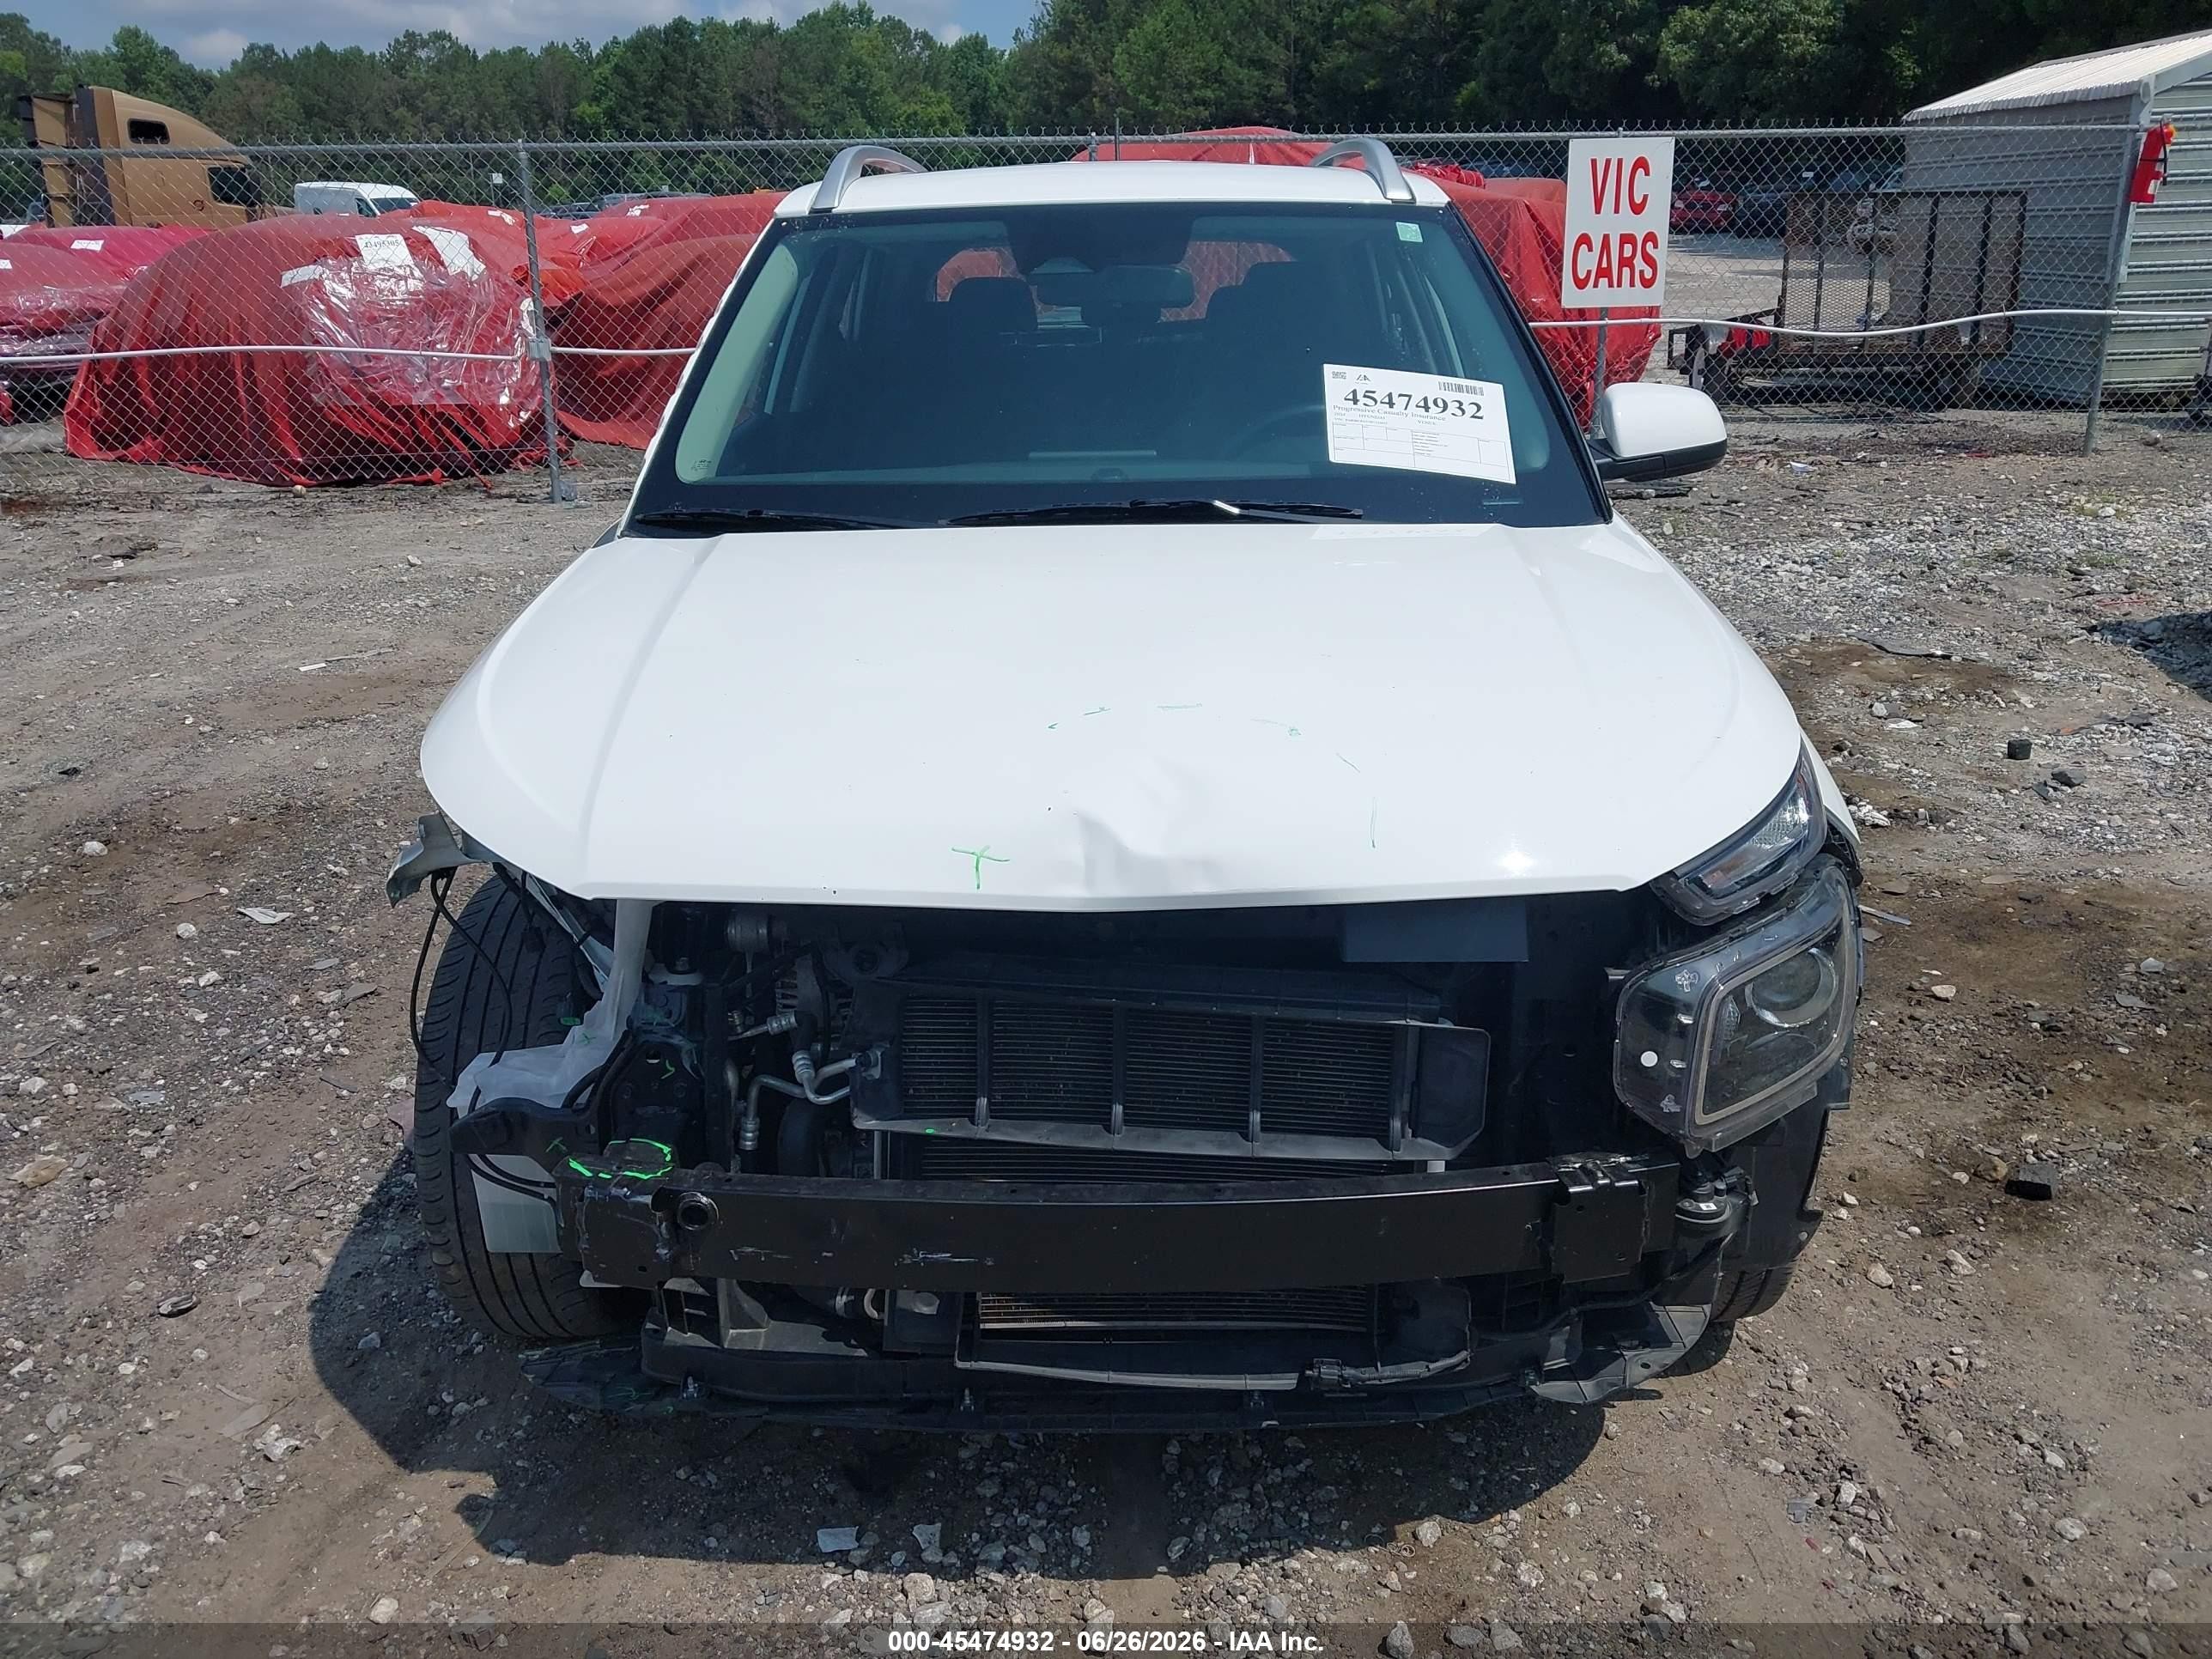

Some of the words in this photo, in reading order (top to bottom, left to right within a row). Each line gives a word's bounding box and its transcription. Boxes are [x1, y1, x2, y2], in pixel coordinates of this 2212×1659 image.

[1590, 155, 1650, 216] VIC
[1571, 231, 1659, 290] CARS
[1333, 404, 1376, 415] Progressive
[1377, 408, 1410, 418] Casualty
[1411, 411, 1447, 422] Insurance
[1344, 388, 1485, 420] 45474932
